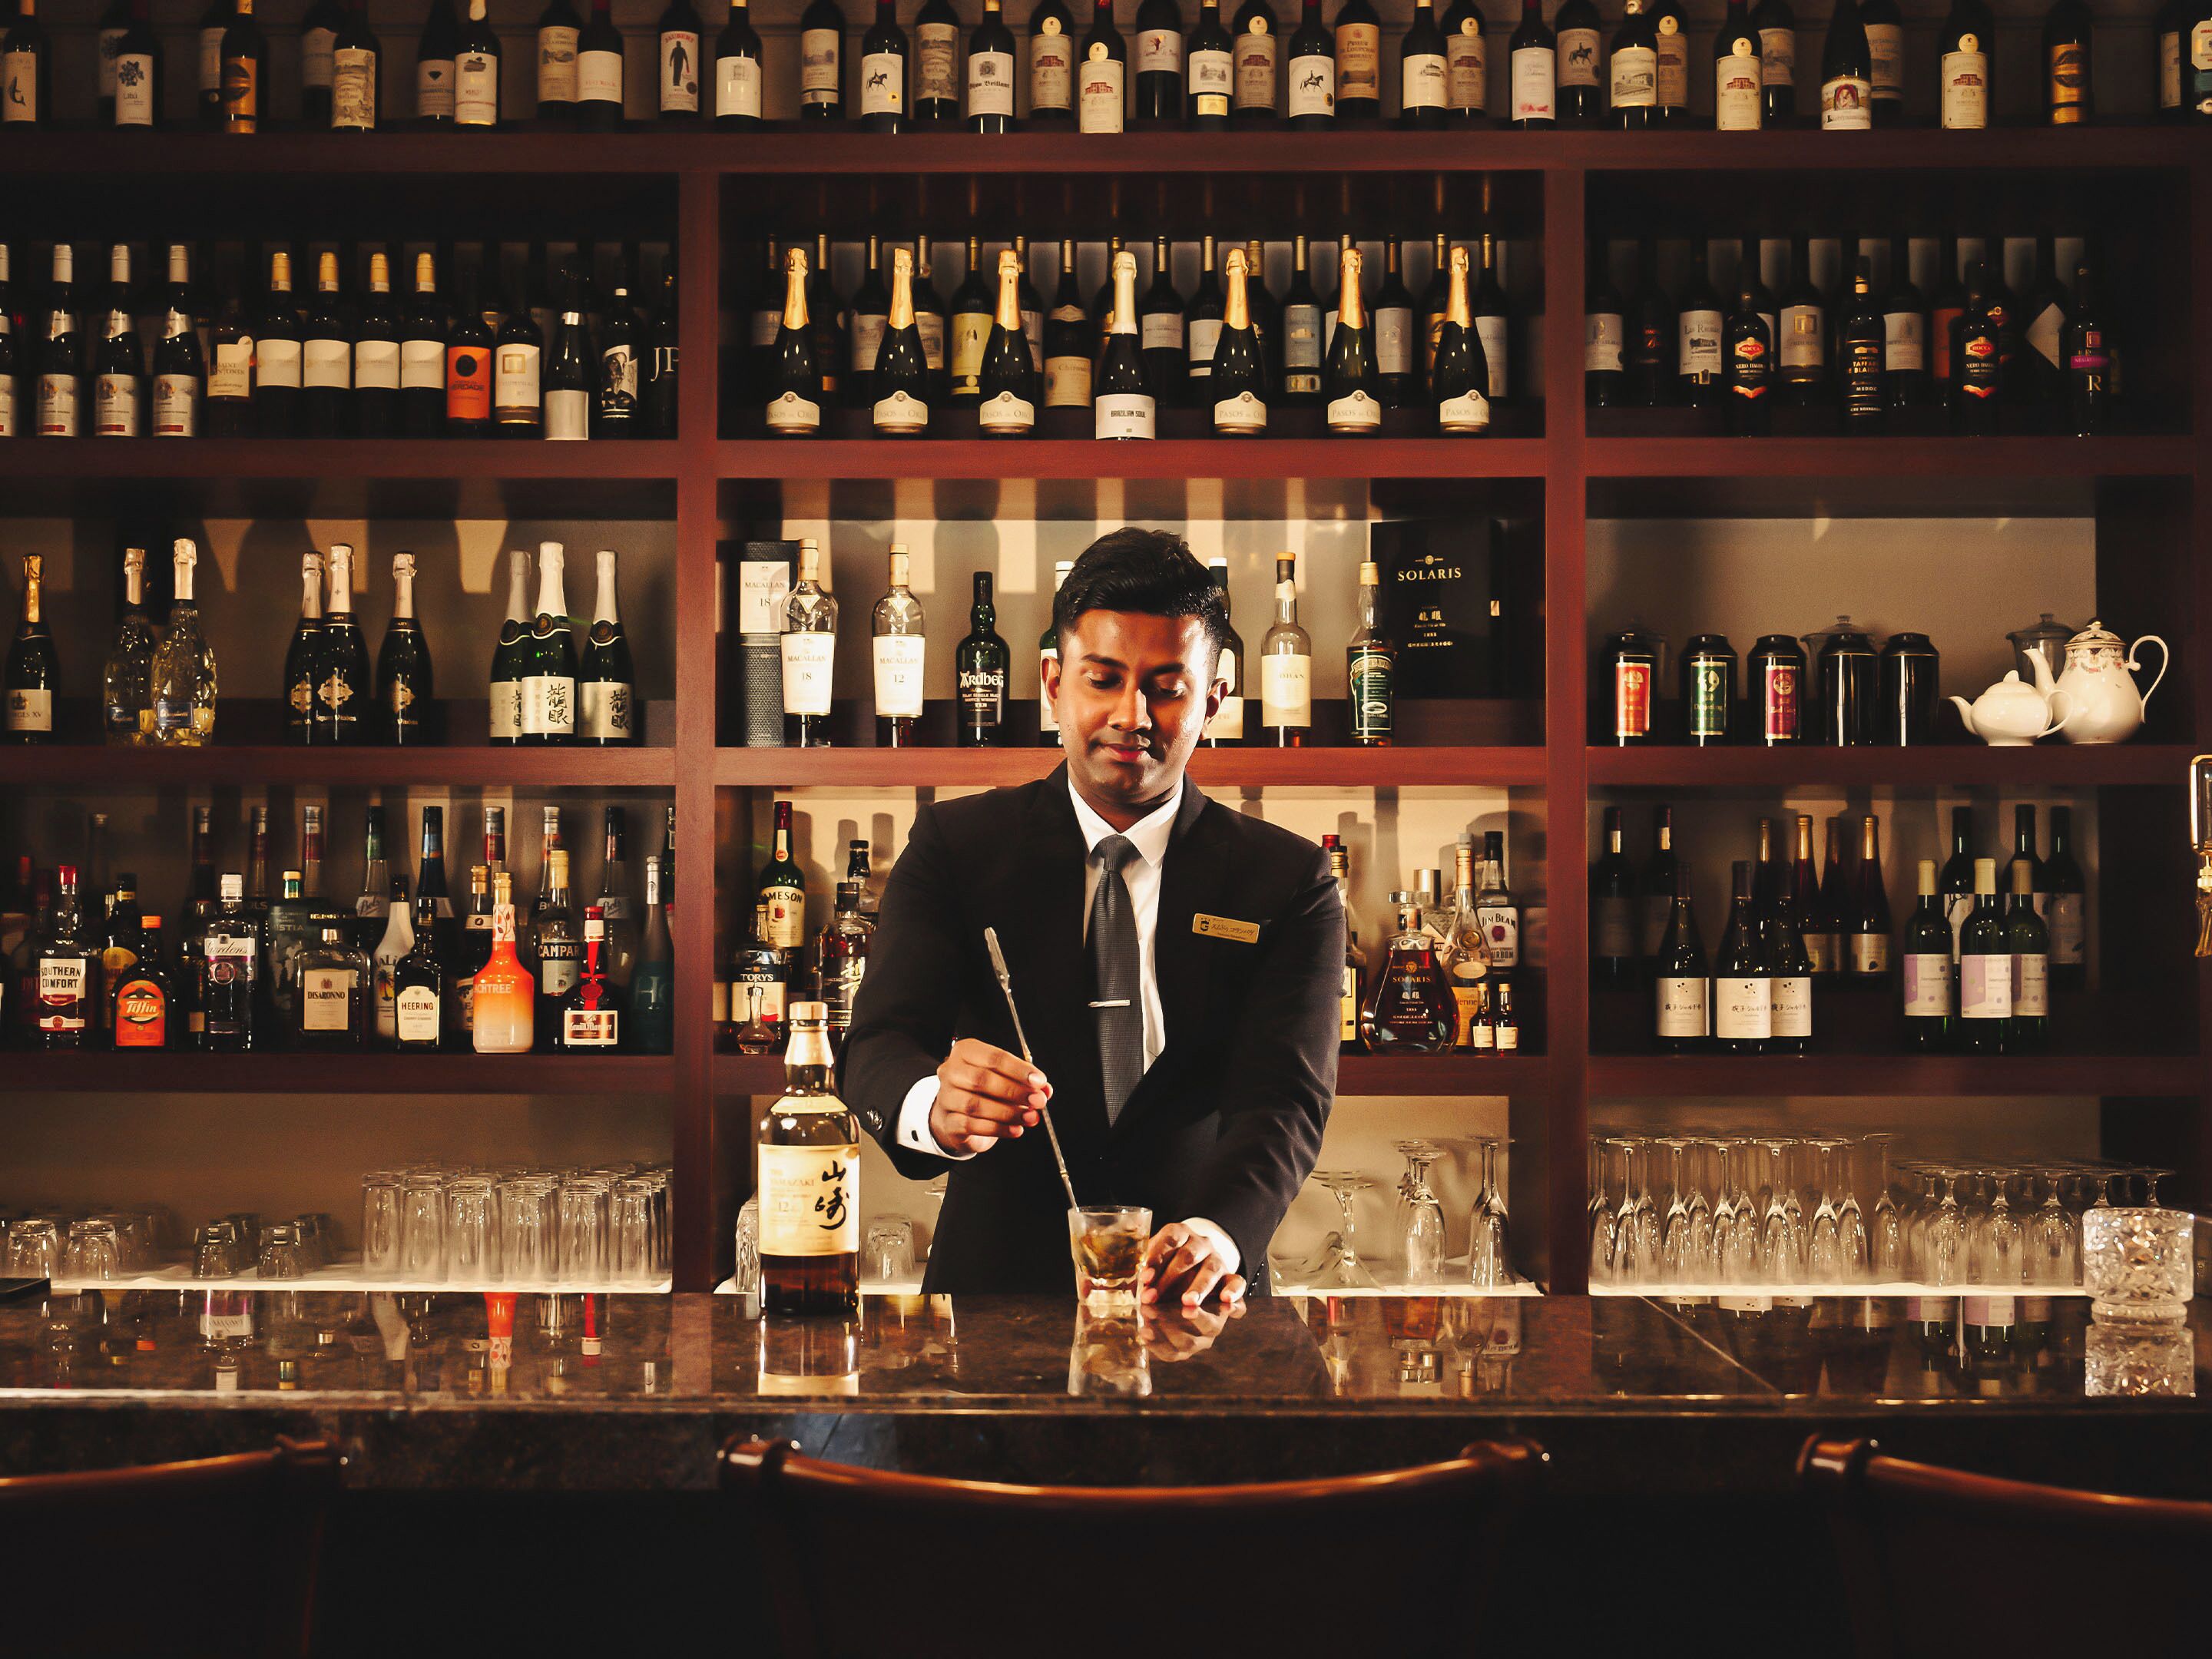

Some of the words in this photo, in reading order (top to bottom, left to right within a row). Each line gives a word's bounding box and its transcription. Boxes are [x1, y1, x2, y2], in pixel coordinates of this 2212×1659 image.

[1111, 409, 1134, 418] BRAZILIAN
[1135, 410, 1147, 419] SOUL
[1397, 568, 1462, 581] SOLARIS
[760, 598, 771, 608] 18
[802, 671, 813, 680] 18
[892, 674, 905, 684] 12
[763, 891, 803, 904] AMESON
[1481, 916, 1495, 929] JIM
[41, 965, 81, 977] SOUTHERN
[740, 973, 774, 982] TORYS
[41, 978, 78, 988] COMFORT
[126, 1000, 157, 1014] Tiffin
[402, 1002, 434, 1011] HEERING
[814, 1159, 850, 1231] 山崎
